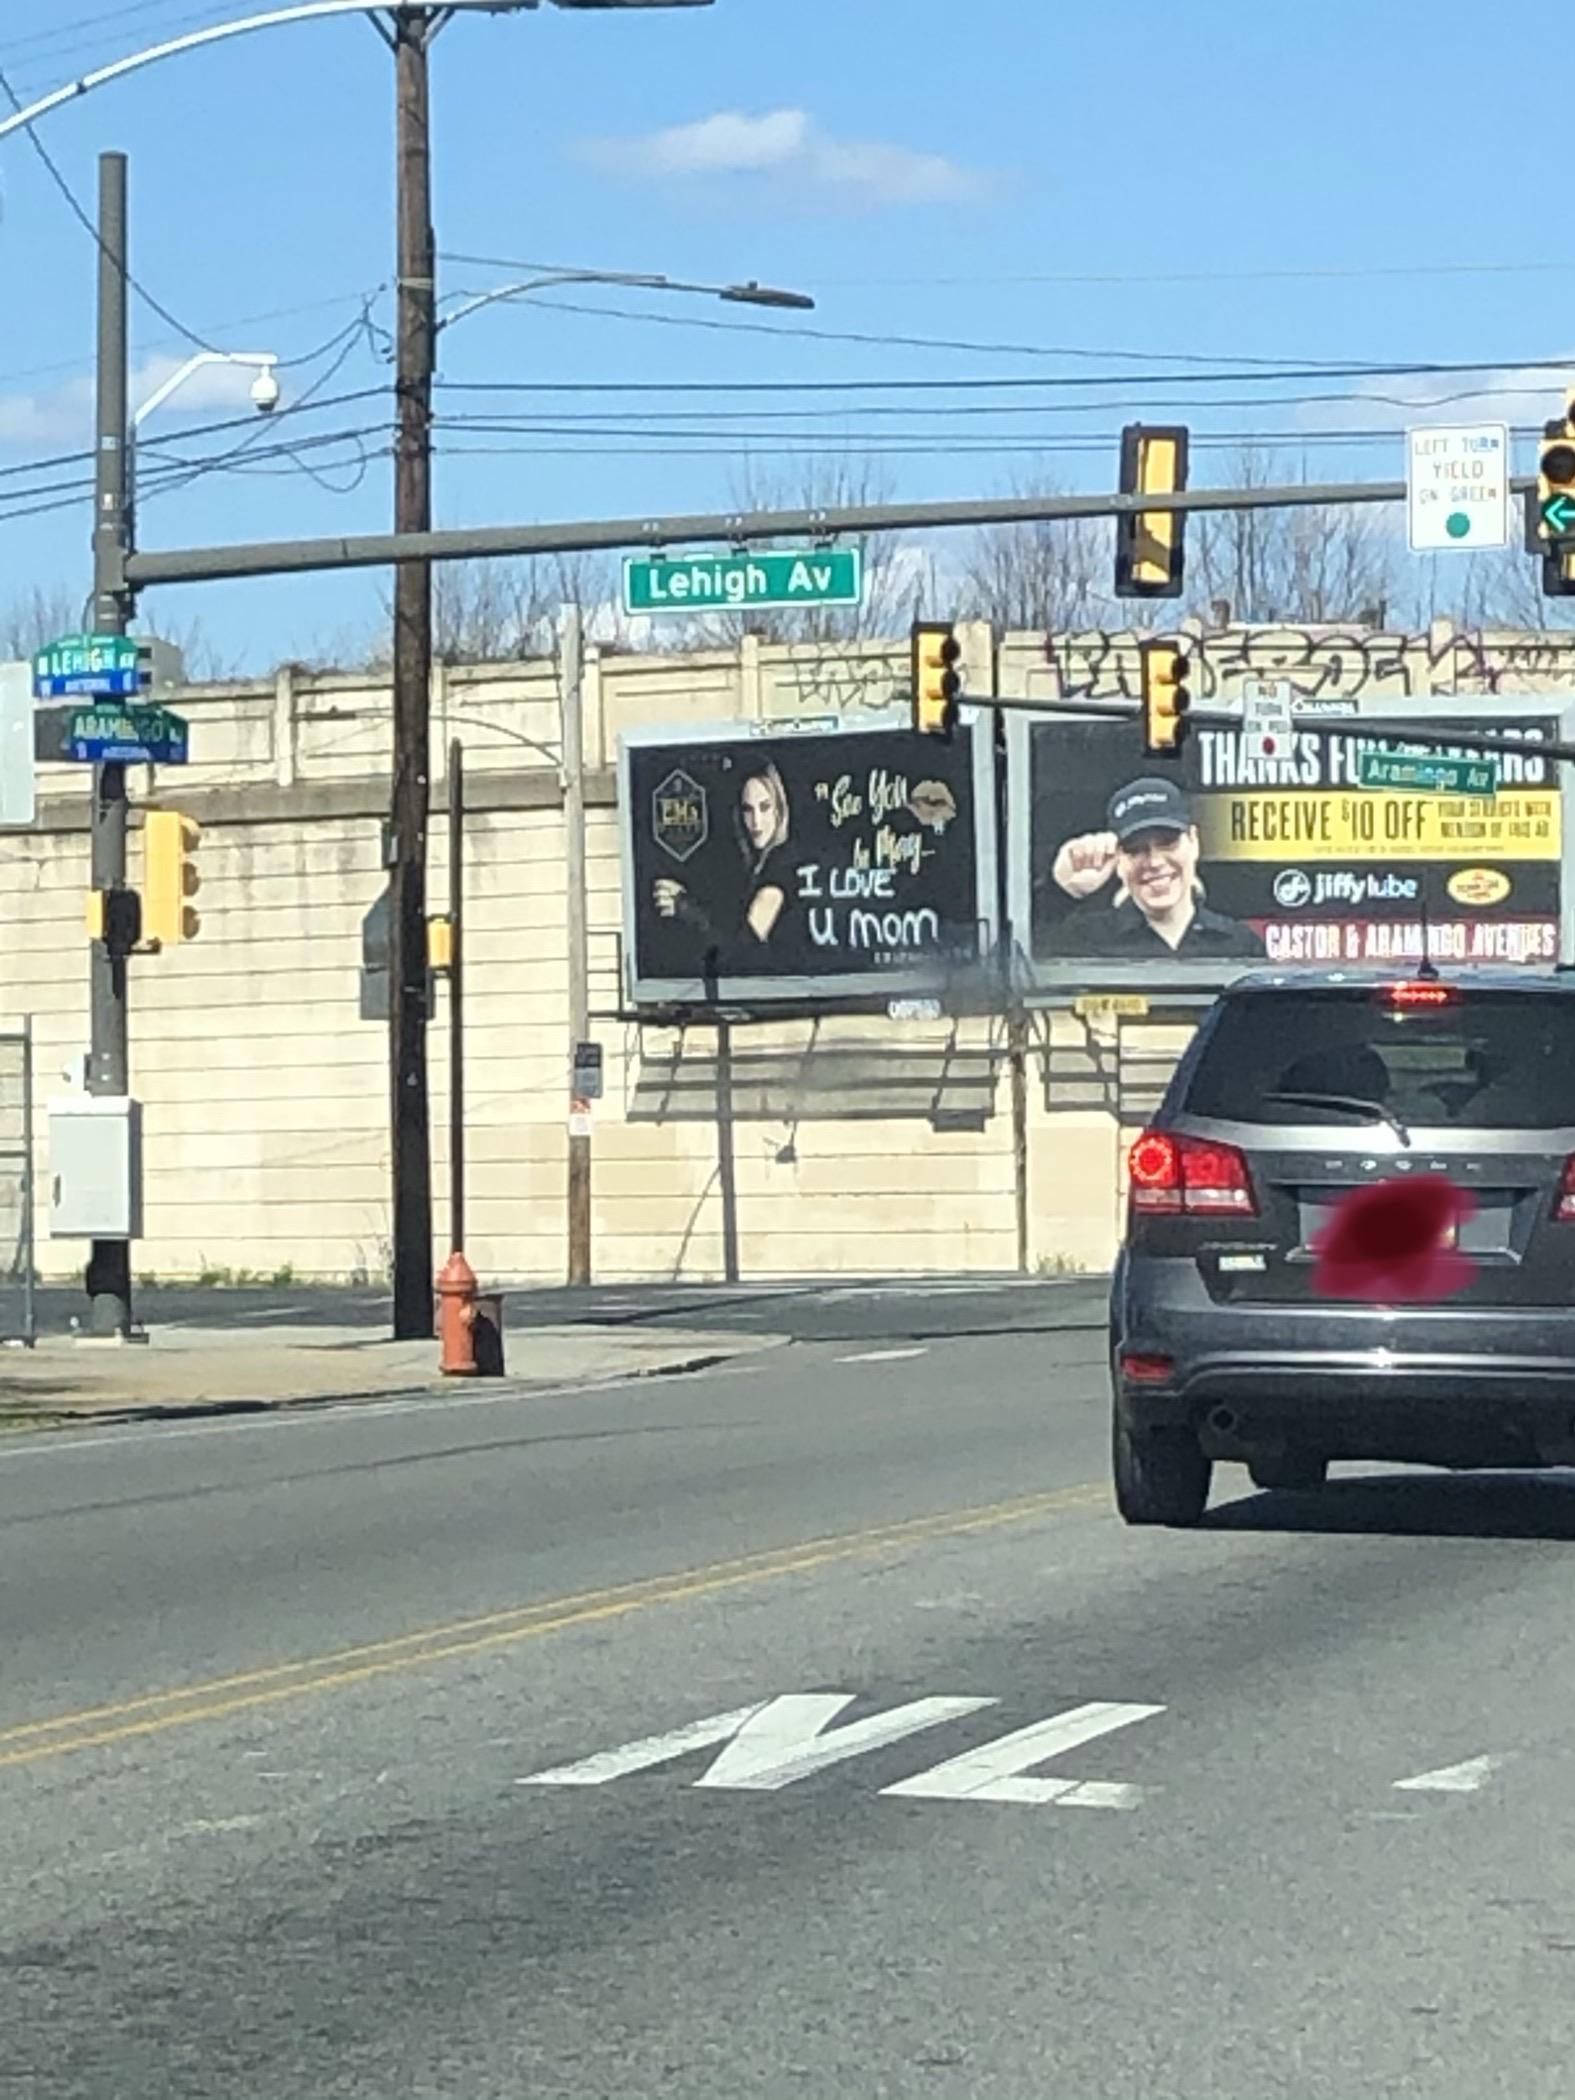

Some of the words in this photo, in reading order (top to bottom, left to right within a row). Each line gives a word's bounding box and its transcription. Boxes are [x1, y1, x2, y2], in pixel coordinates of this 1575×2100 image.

[1415, 438, 1448, 455] LEFT
[1462, 437, 1499, 453] TURN
[1433, 460, 1483, 479] YIELD
[650, 564, 767, 602] Lehigh
[788, 561, 832, 592] Av
[1231, 800, 1332, 841] RECEIVE
[1384, 800, 1429, 840] OFF
[1265, 923, 1341, 959] CASTOR
[1346, 923, 1360, 957] &
[1365, 922, 1467, 957] ARAMNGO
[1471, 922, 1556, 958] AVENUES
